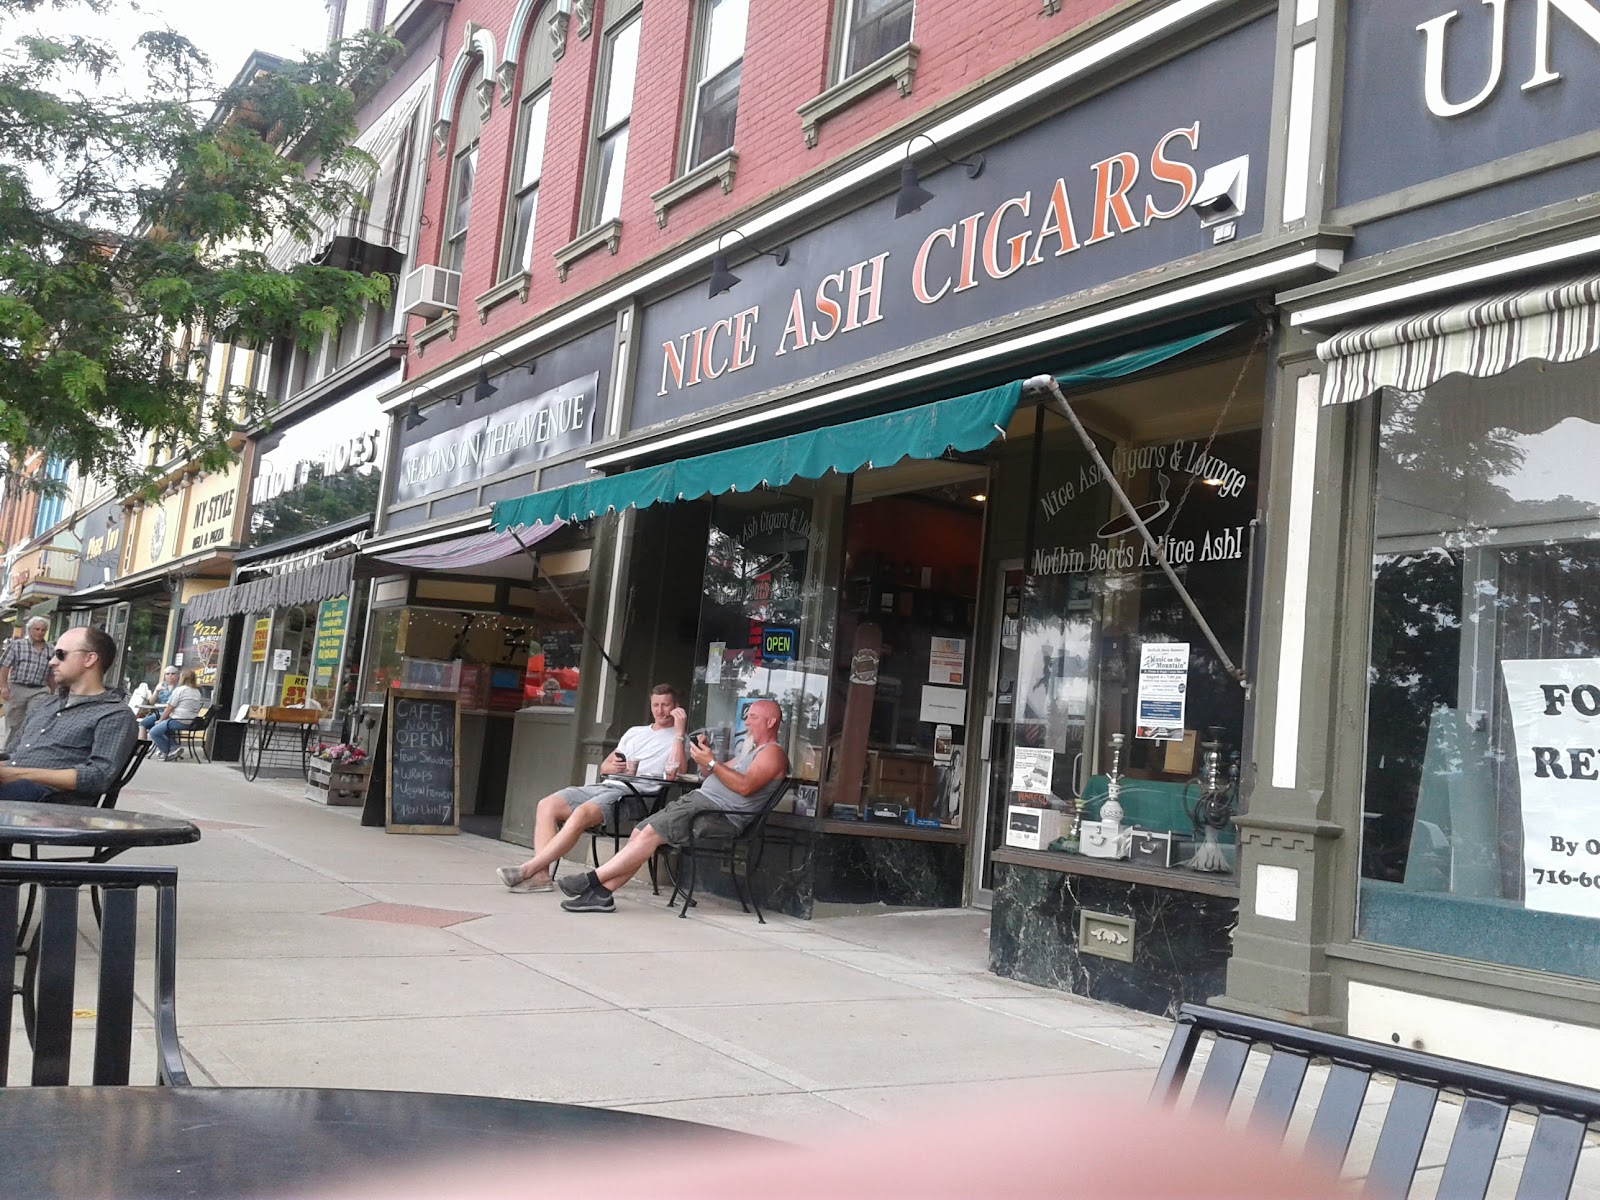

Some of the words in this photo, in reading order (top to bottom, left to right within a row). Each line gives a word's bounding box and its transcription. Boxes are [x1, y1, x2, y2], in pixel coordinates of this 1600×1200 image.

[657, 305, 759, 396] NICE
[775, 251, 889, 356] ASH
[911, 120, 1200, 303] CIGARS
[405, 443, 458, 485] SEASONS
[458, 432, 481, 468] ON
[485, 421, 516, 460] THE
[513, 394, 584, 447] AVENUE
[1040, 481, 1075, 522] Nice
[1079, 460, 1108, 494] Ash
[1112, 446, 1166, 478] Cigars
[1170, 439, 1184, 472] &
[1184, 441, 1246, 498] Lounge
[193, 500, 208, 529] NY
[207, 489, 234, 523] STYLE
[743, 516, 758, 543] Ash
[760, 511, 789, 535] Cigars
[789, 508, 798, 531] &
[192, 535, 203, 549] DELI
[203, 532, 208, 546] &
[209, 527, 224, 544] PIZZA
[1033, 546, 1084, 576] Nothin
[1088, 540, 1134, 571] Beats
[1138, 539, 1151, 567] A
[1199, 526, 1244, 562] Ash!
[193, 620, 224, 637] PIZZA
[766, 636, 791, 652] OPEN
[396, 699, 442, 722] CAFE
[405, 720, 439, 732] NOW
[1532, 747, 1600, 781] RE
[1550, 835, 1579, 857] By
